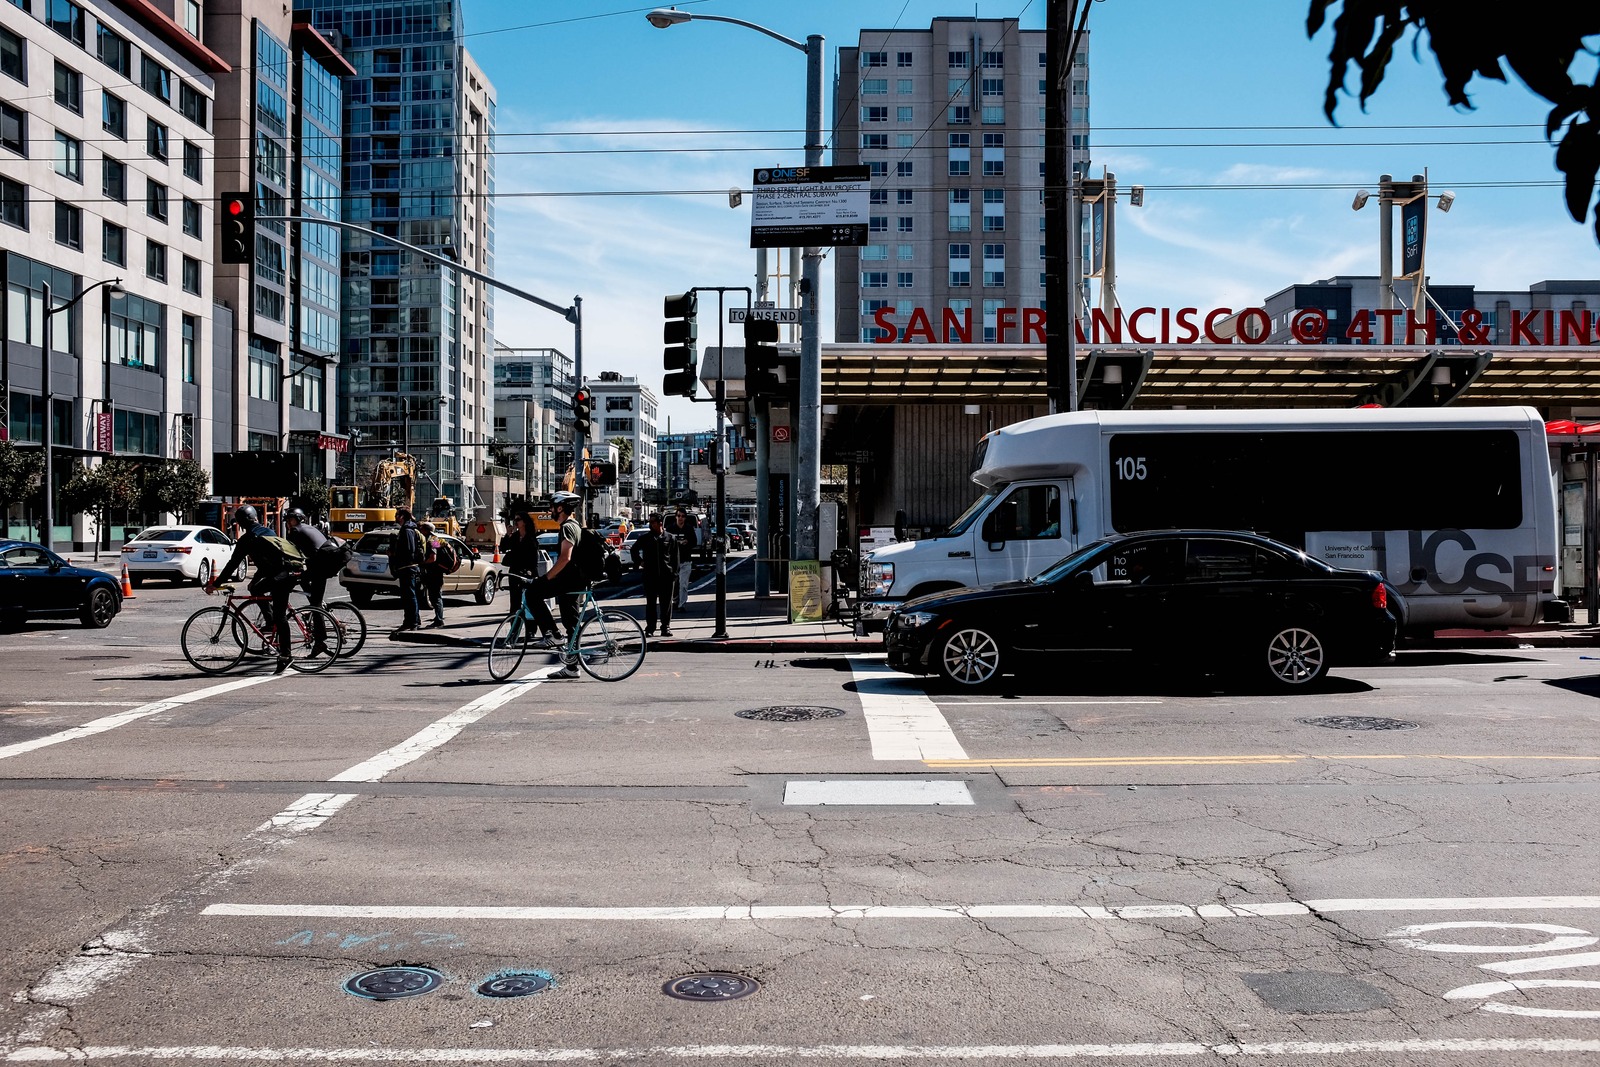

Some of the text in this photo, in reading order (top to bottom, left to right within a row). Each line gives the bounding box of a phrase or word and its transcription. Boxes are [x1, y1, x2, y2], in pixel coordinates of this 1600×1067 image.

[772, 168, 810, 178] ONESF
[1406, 244, 1418, 258] SoFi
[732, 311, 796, 320] TONSEND
[874, 307, 972, 344] SAN
[1290, 308, 1328, 345] @
[1346, 309, 1436, 346] 4TH
[1458, 308, 1492, 346] &
[1115, 456, 1148, 480] 105
[348, 522, 365, 533] CAT
[1372, 529, 1556, 618] UCSF
